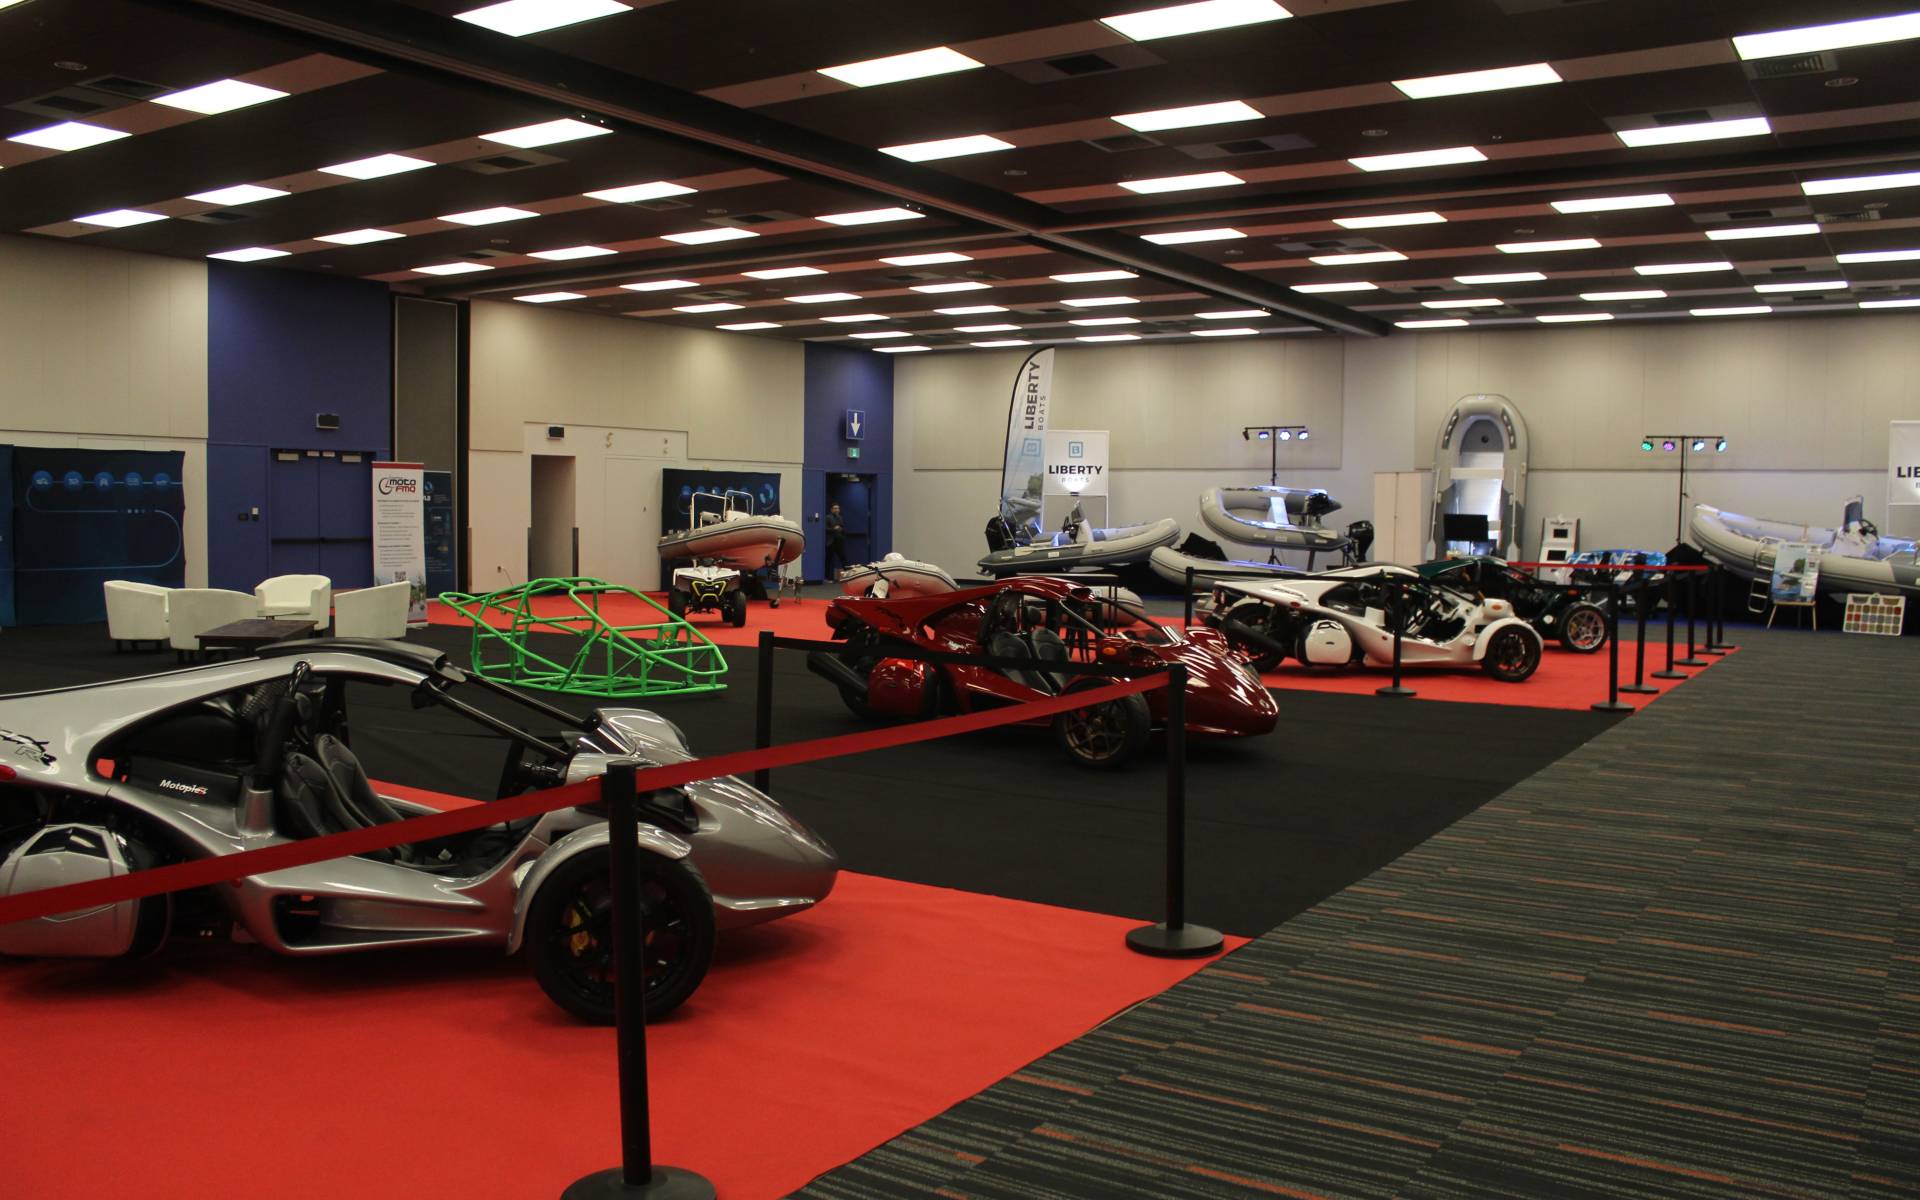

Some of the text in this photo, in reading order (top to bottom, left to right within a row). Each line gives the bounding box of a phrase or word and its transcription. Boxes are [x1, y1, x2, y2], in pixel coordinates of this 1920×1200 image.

[1024, 361, 1041, 430] LIBERTY
[1037, 395, 1047, 431] BOATS
[1048, 464, 1103, 475] LIBERTY
